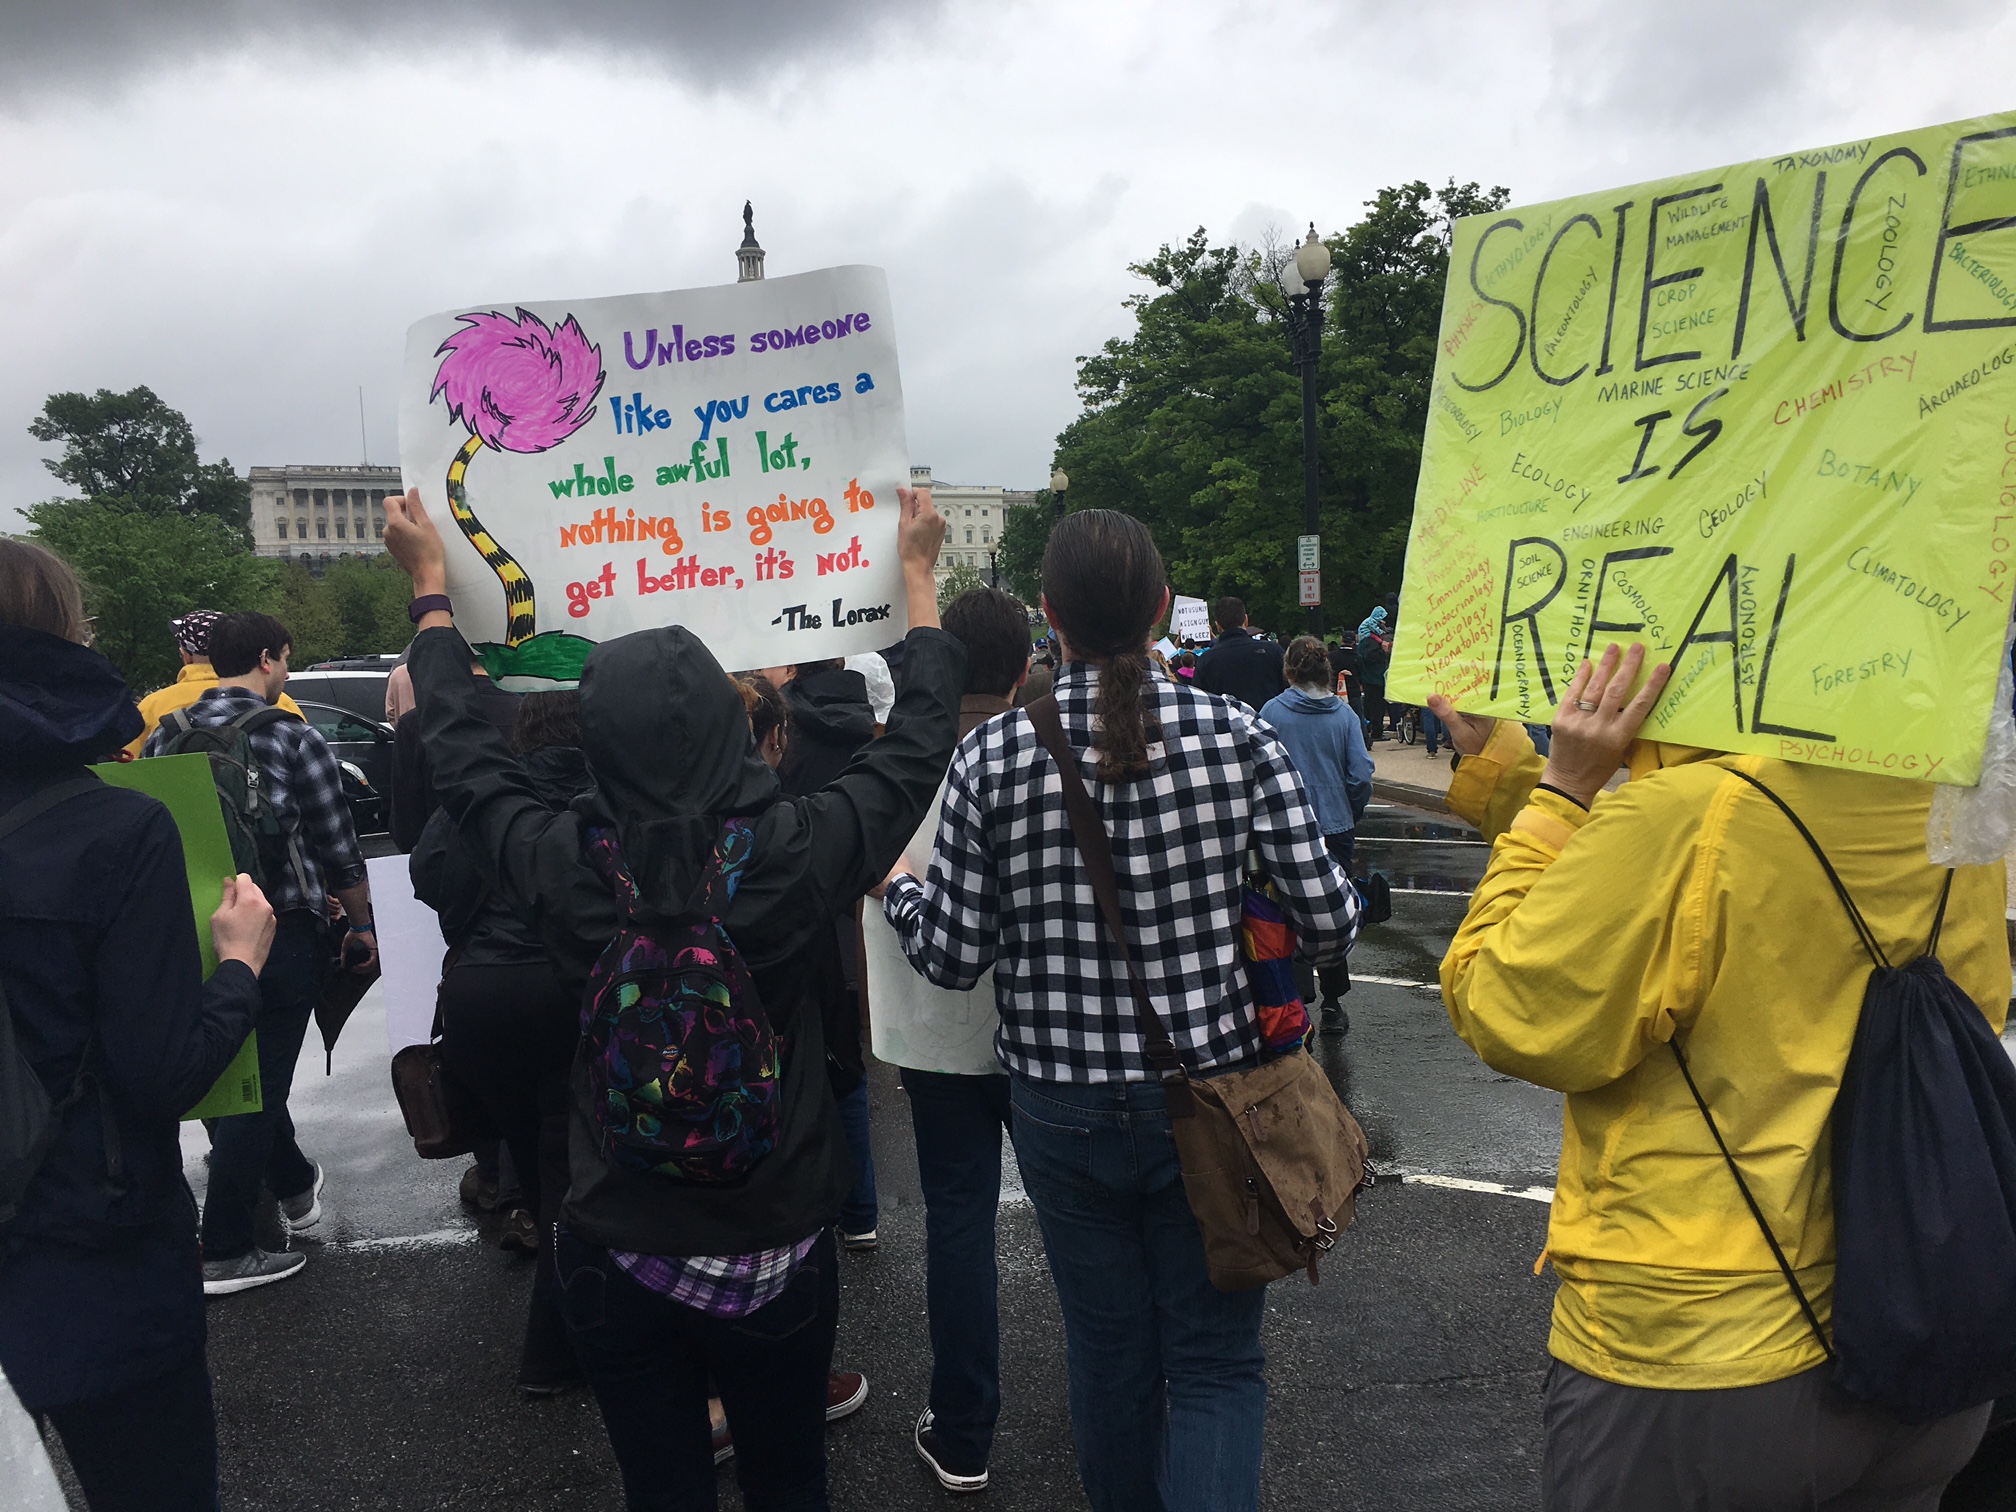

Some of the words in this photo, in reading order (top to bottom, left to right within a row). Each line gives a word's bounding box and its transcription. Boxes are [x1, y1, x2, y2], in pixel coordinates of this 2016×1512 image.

[1772, 141, 1871, 174] TAXONOMY
[1666, 215, 1750, 249] MANAGEMENT
[1668, 196, 1729, 224] WILDLIFE
[1451, 127, 2016, 392] SCIENCE
[1865, 193, 1907, 311] ZOOLOGY
[1544, 266, 1598, 357] PALEONTOLOGY
[1652, 308, 1716, 339] SCIENCE
[1657, 284, 1697, 307] CROP
[1443, 300, 1484, 357] PHYSICS
[609, 392, 672, 436] like
[693, 395, 750, 441] you
[763, 381, 842, 413] cares
[854, 372, 875, 394] a
[1598, 377, 1663, 402] MARINE
[1675, 363, 1752, 392] SCIENCE
[1774, 350, 1917, 425] CHEMISTRY
[1919, 343, 2016, 419] ARCHAEOLOG
[1500, 397, 1563, 437] BIOLOGY
[1618, 388, 1730, 484] IS
[547, 456, 635, 500] whole
[655, 437, 731, 486] awful
[756, 431, 811, 473] lot,
[1511, 452, 1592, 513] ECOLOGY
[1817, 449, 1923, 507] BOTANY
[559, 506, 684, 555] nothing
[701, 501, 732, 533] is
[746, 493, 835, 546] going
[843, 477, 875, 513] to
[1477, 497, 1551, 523] HORTICULTURE
[1562, 517, 1665, 541] ENGINEERING
[1699, 470, 1766, 538] GEOLOGY
[566, 561, 617, 619] get
[636, 553, 744, 596] better,
[755, 547, 795, 582] it's
[1427, 557, 1491, 614] Immunology
[1517, 563, 1553, 589] SCIENCE
[1519, 553, 1542, 570] SOIL
[1847, 546, 1971, 632] CLIMATOLOGY
[832, 598, 892, 628] Lorax
[1490, 537, 1837, 742] REAL
[1560, 558, 1596, 687] ORNITHOLOGY
[1612, 570, 1674, 652] COSMOLOGY
[1740, 565, 1759, 685] ASTRONOMY
[1435, 651, 1485, 696] Oncology
[1512, 624, 1531, 719] OCEANOGRAPHY
[1655, 645, 1716, 729] HERPETOLOGY
[1812, 648, 1912, 696] FORESTRY
[1780, 739, 1944, 778] PSYCHOLOGY
